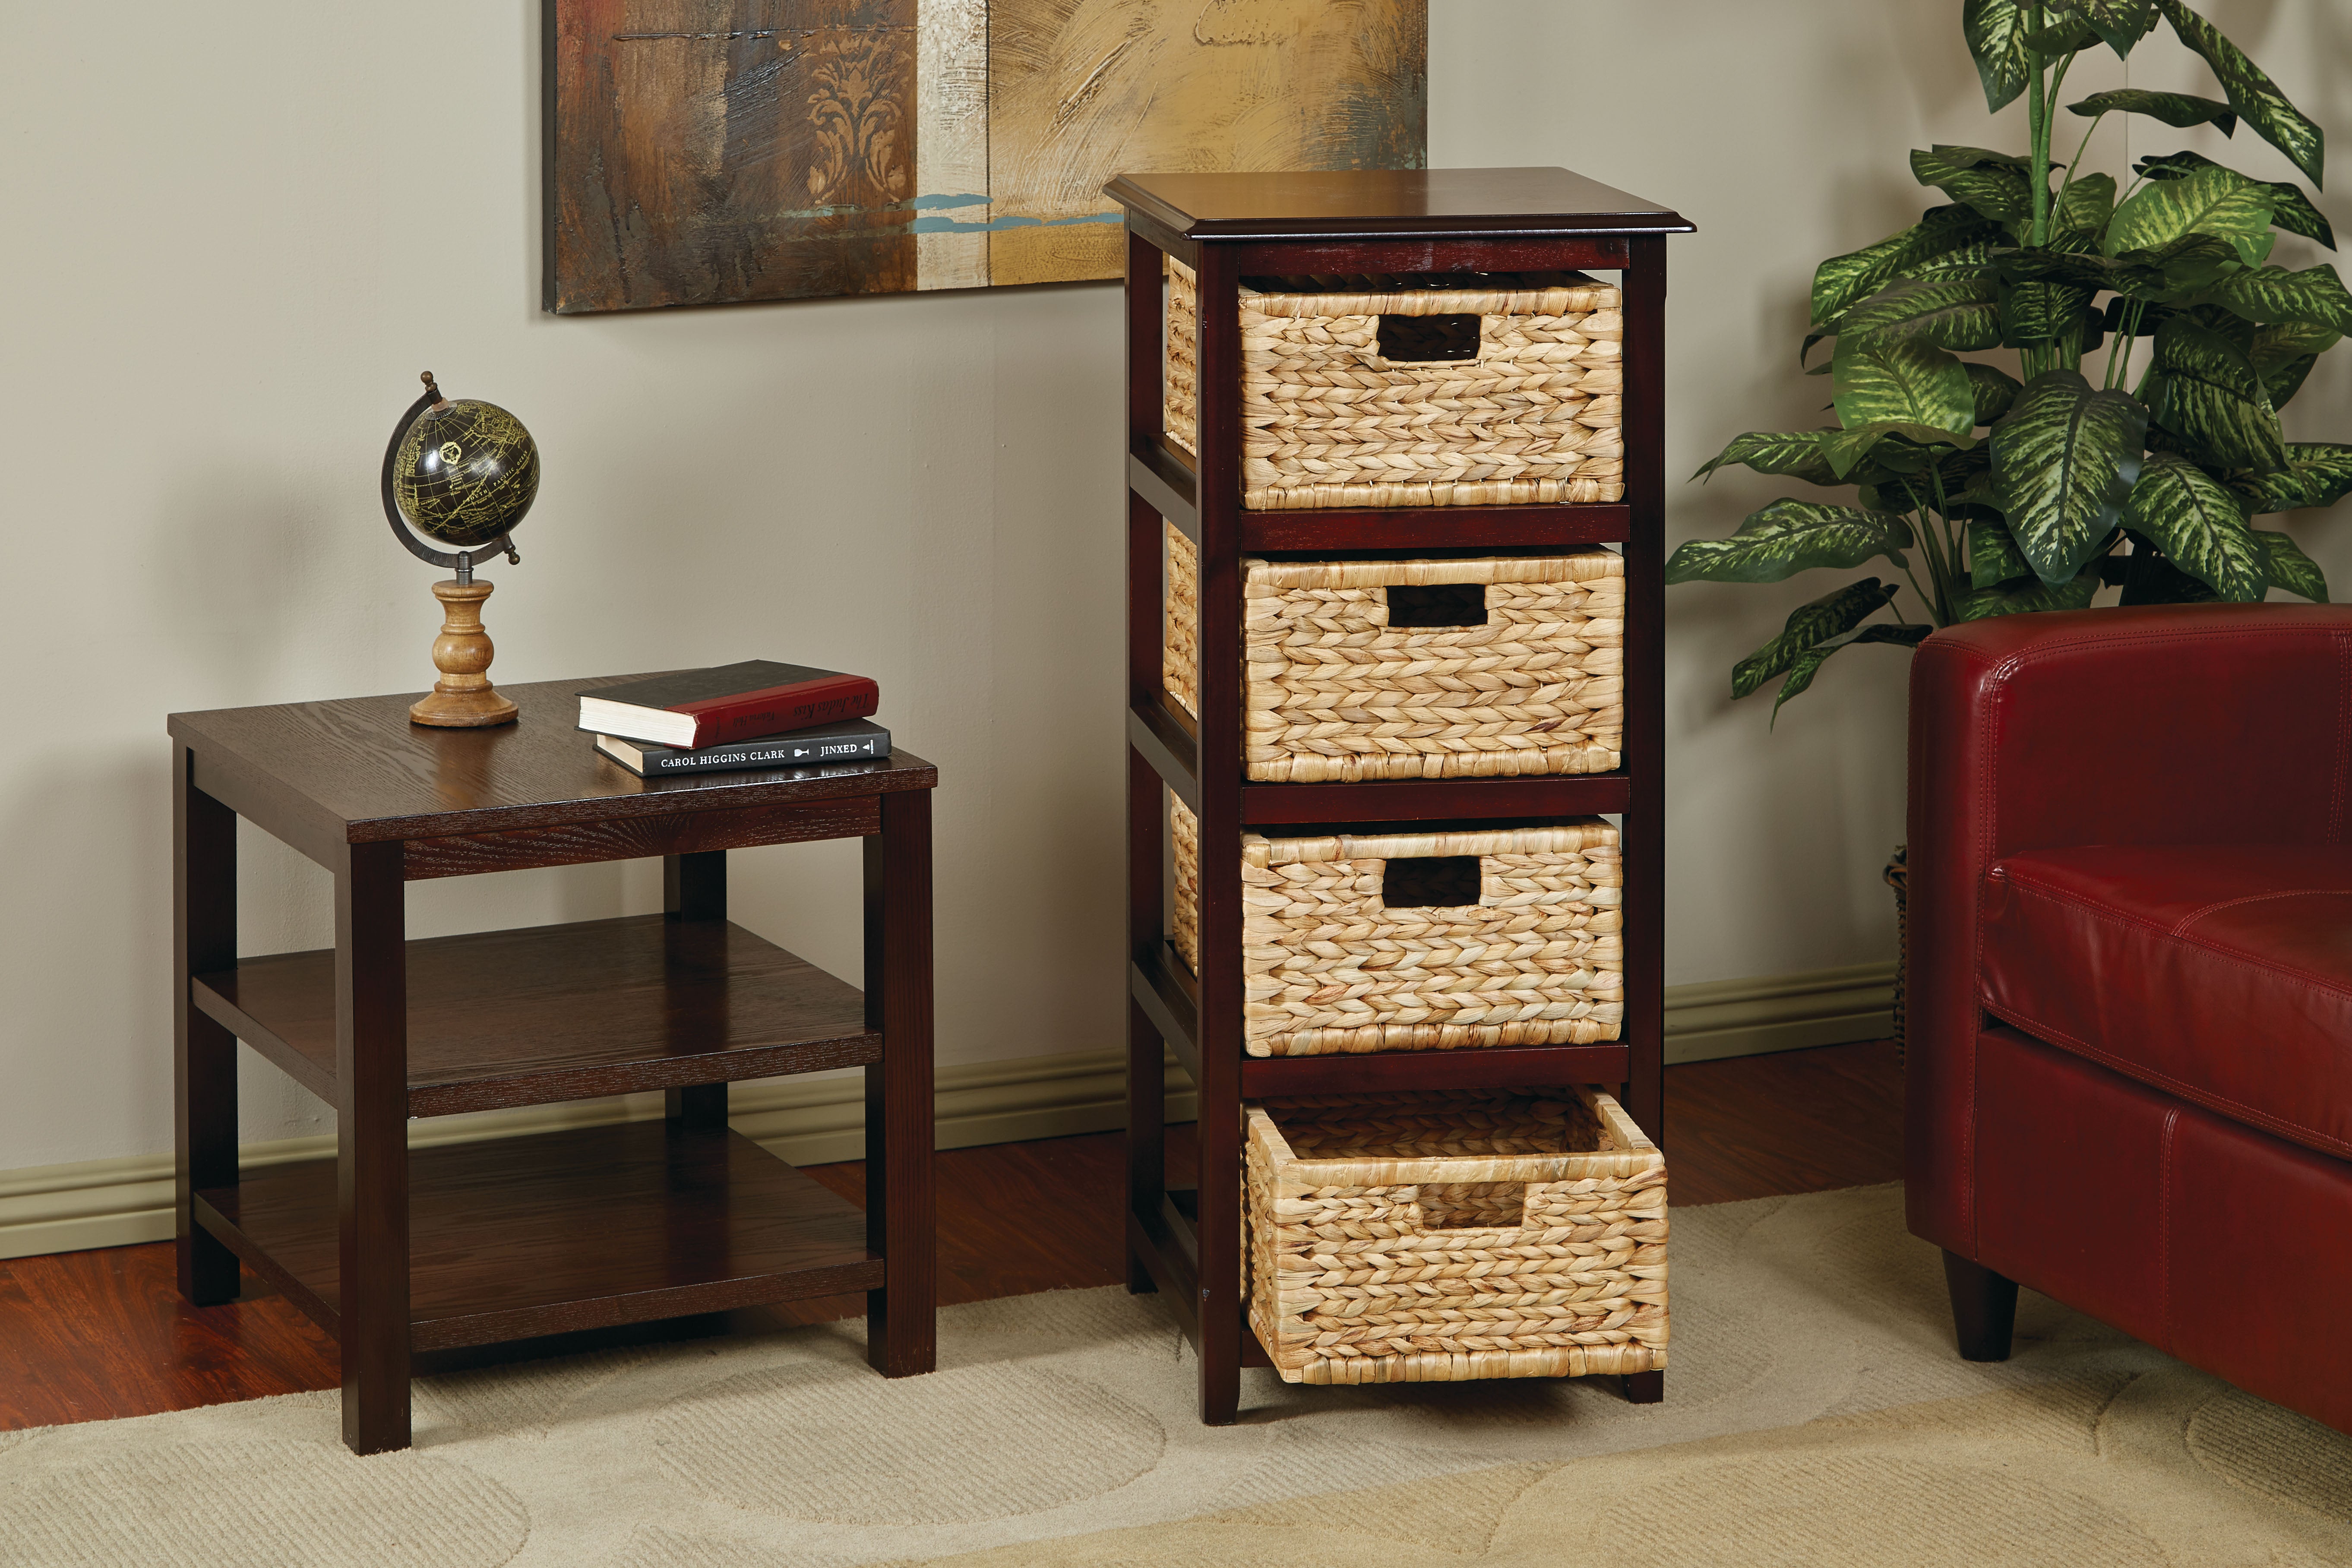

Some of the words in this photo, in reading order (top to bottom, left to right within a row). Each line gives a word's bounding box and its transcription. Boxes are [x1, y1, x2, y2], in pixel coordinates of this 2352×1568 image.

[467, 489, 488, 502] SOUTH
[493, 467, 515, 487] PACIFIC
[516, 450, 528, 466] OCEAN
[818, 698, 849, 715] Judas
[851, 693, 869, 709] The
[749, 711, 775, 721] Victoria
[793, 703, 815, 720] Kiss
[733, 716, 747, 727] Holt
[661, 757, 696, 767] CAROL
[700, 753, 746, 765] HIGGINS
[750, 749, 785, 760] CLARK
[820, 744, 857, 756] JINXED
